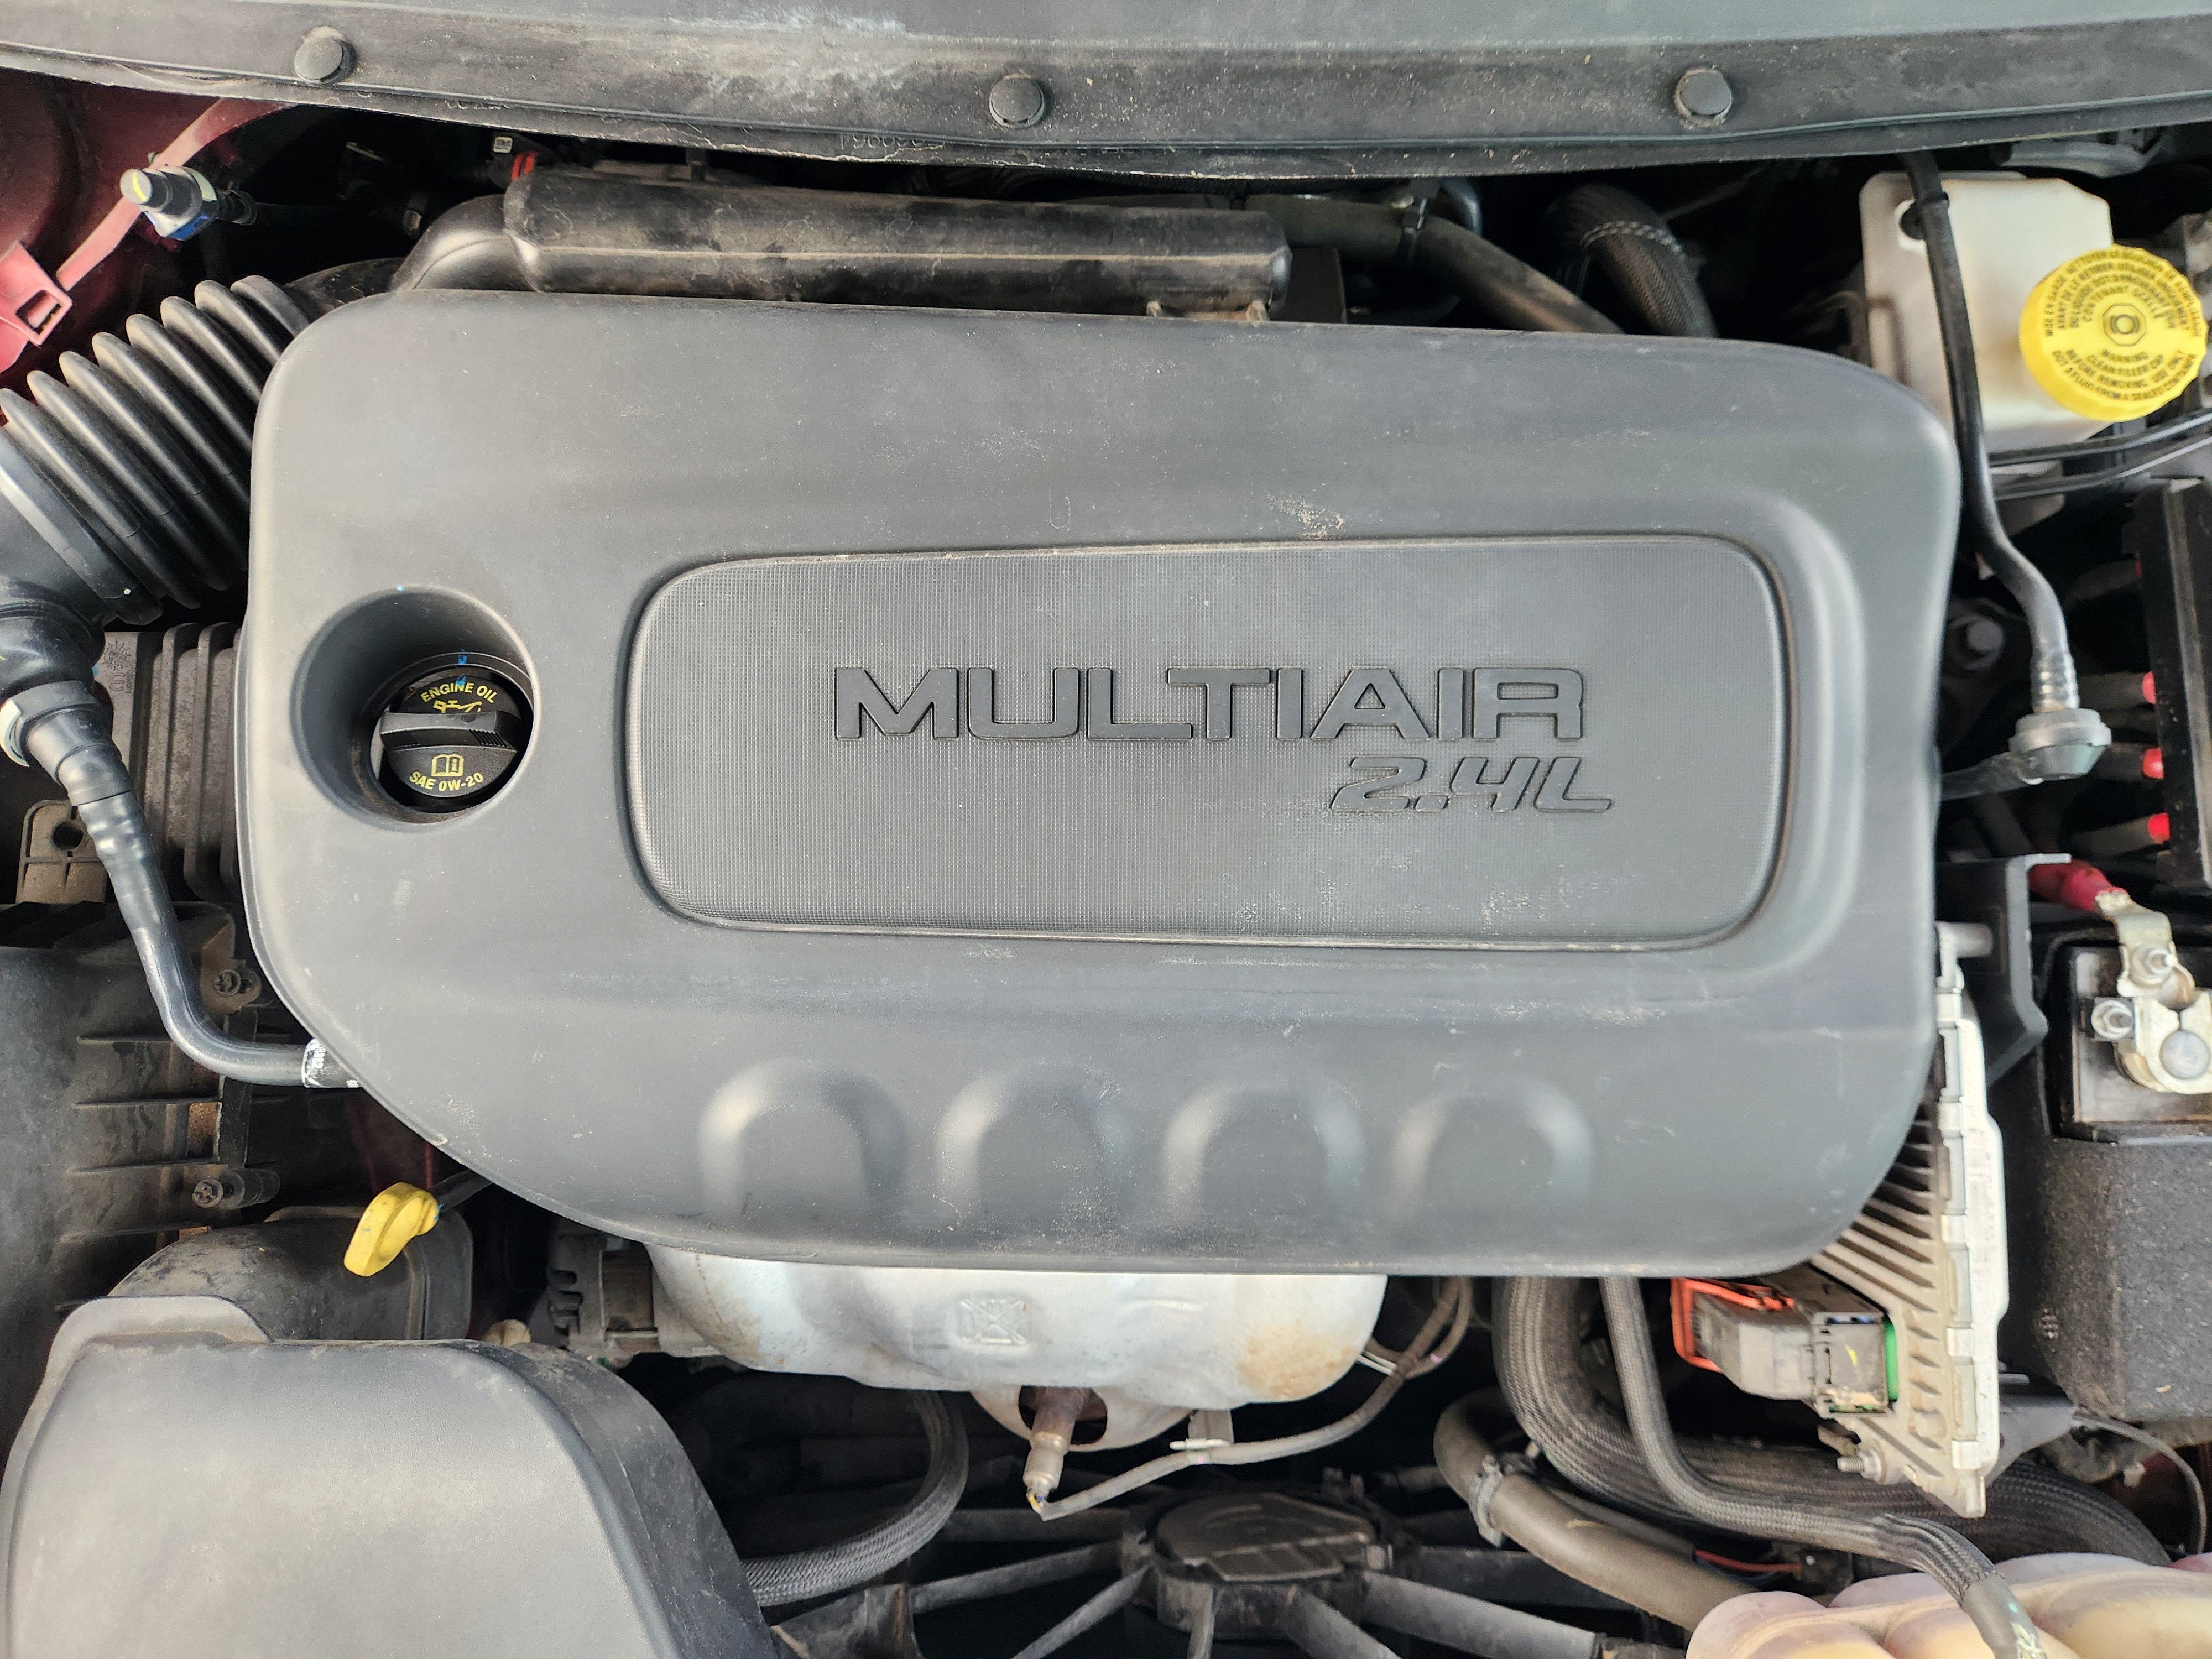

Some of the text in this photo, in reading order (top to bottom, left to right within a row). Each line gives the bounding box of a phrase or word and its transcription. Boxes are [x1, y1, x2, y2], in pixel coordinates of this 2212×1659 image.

[420, 682, 497, 703] ENGINE OIL
[834, 667, 1585, 741] MULTIAIR
[409, 771, 484, 791] SAE 0W-20
[1329, 756, 1613, 813] 2.4L
